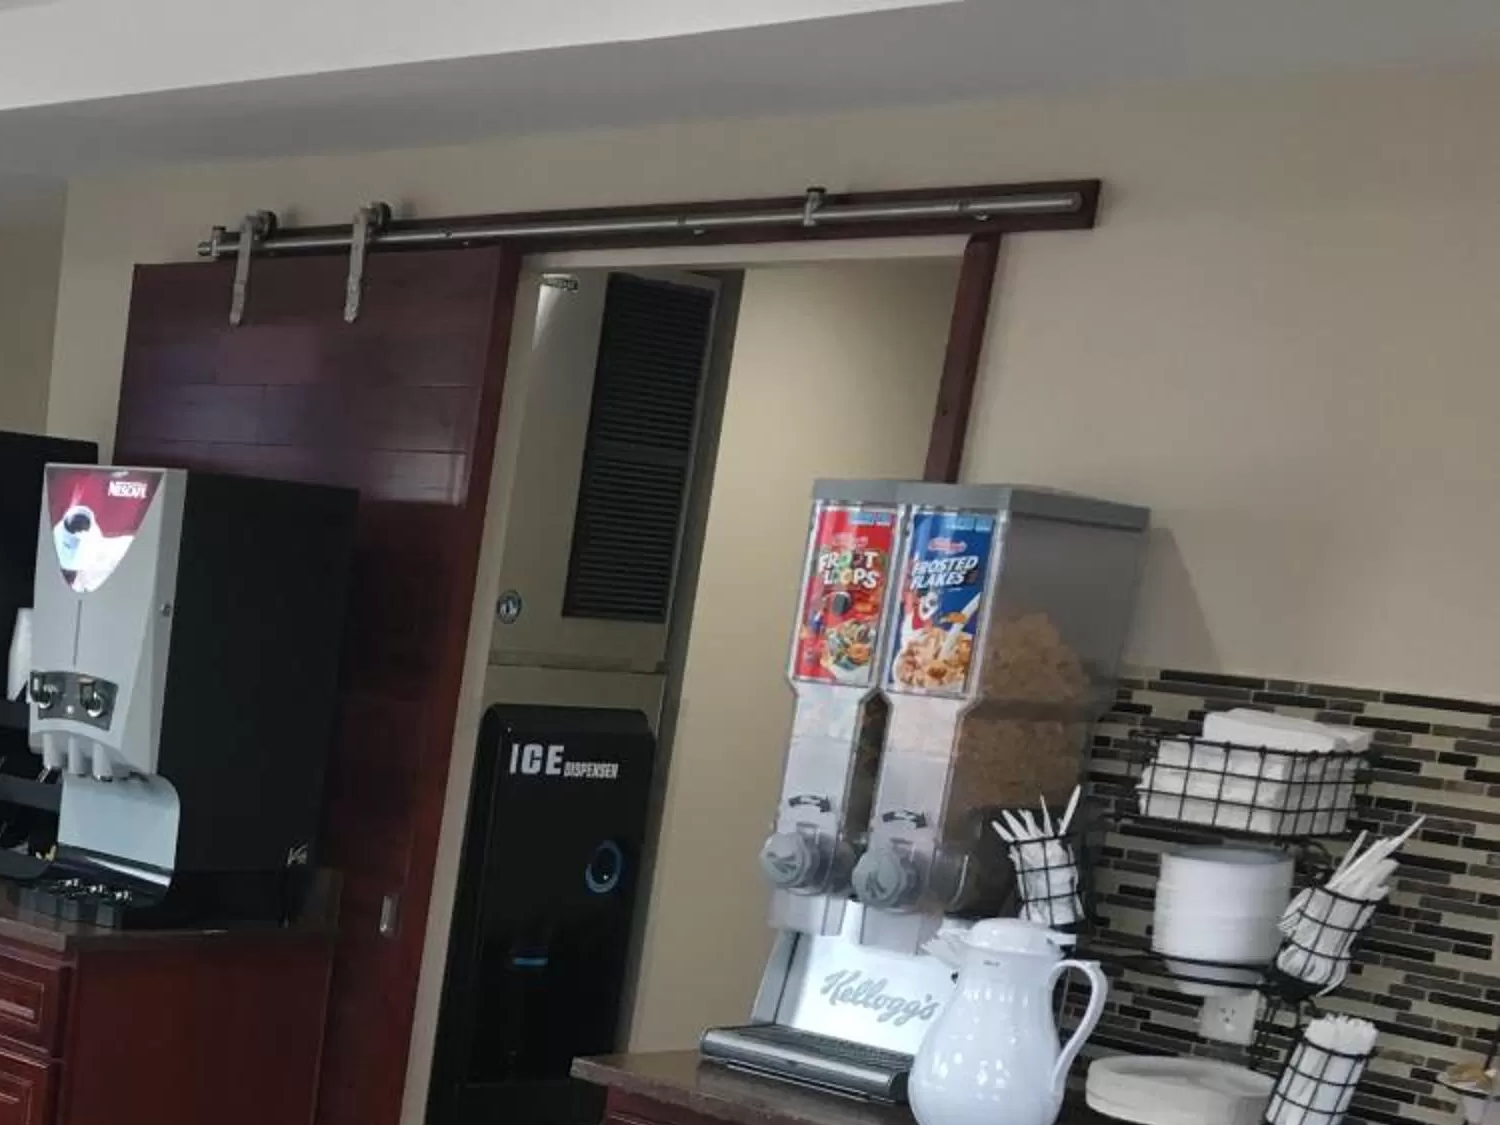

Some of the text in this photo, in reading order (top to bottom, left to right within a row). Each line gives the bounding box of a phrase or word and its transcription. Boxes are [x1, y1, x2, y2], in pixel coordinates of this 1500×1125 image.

[911, 554, 979, 577] FROSTED
[823, 567, 881, 589] LOOPS
[910, 570, 965, 590] FLAKES
[509, 743, 619, 779] ICE DISPENSER
[819, 969, 940, 1026] Kellogg's
